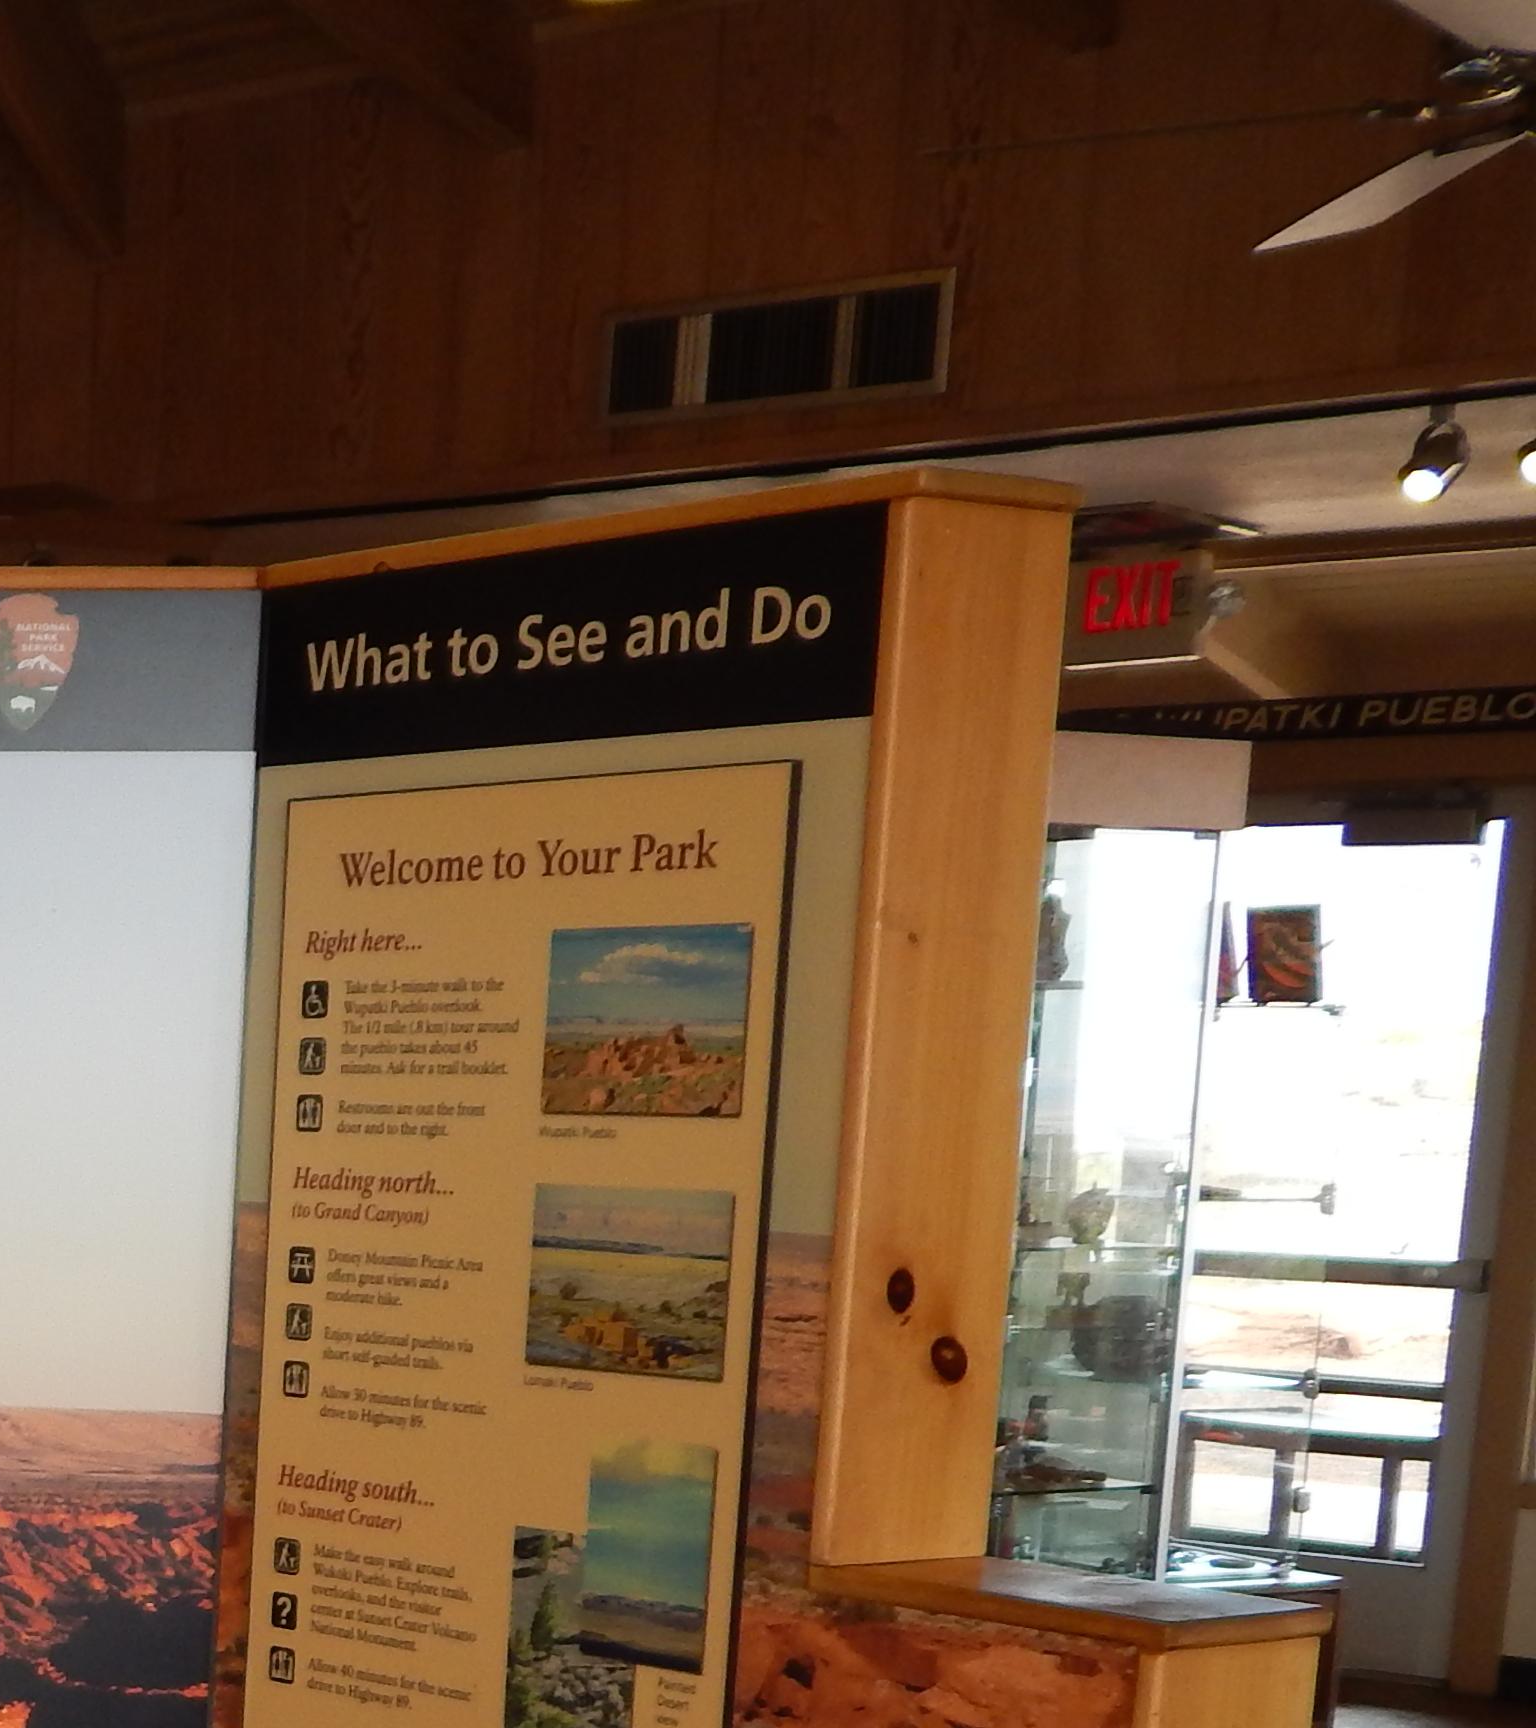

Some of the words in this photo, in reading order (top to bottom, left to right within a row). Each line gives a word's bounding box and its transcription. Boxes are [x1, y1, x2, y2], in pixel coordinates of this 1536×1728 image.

[1084, 560, 1182, 633] EXIT
[16, 623, 70, 632] NATIONAL
[307, 632, 432, 692] What
[447, 628, 499, 678] to
[517, 615, 604, 671] See
[625, 587, 729, 659] and
[751, 586, 832, 645] Do
[21, 643, 65, 652] SERVICE
[341, 849, 483, 888] Welcome
[493, 848, 525, 879] to
[537, 837, 622, 877] Your
[631, 828, 719, 871] Park
[306, 929, 358, 961] Right
[362, 928, 422, 951] here...
[293, 1167, 375, 1198] Heading
[379, 1171, 454, 1195] north...
[292, 1203, 310, 1218] (to
[314, 1202, 360, 1220] Grand
[365, 1204, 429, 1227] Canyon)
[279, 1464, 358, 1502] Heading
[362, 1480, 434, 1507] south...
[278, 1497, 296, 1515] (to
[298, 1501, 345, 1523] Sunset
[348, 1507, 402, 1533] Crater)
